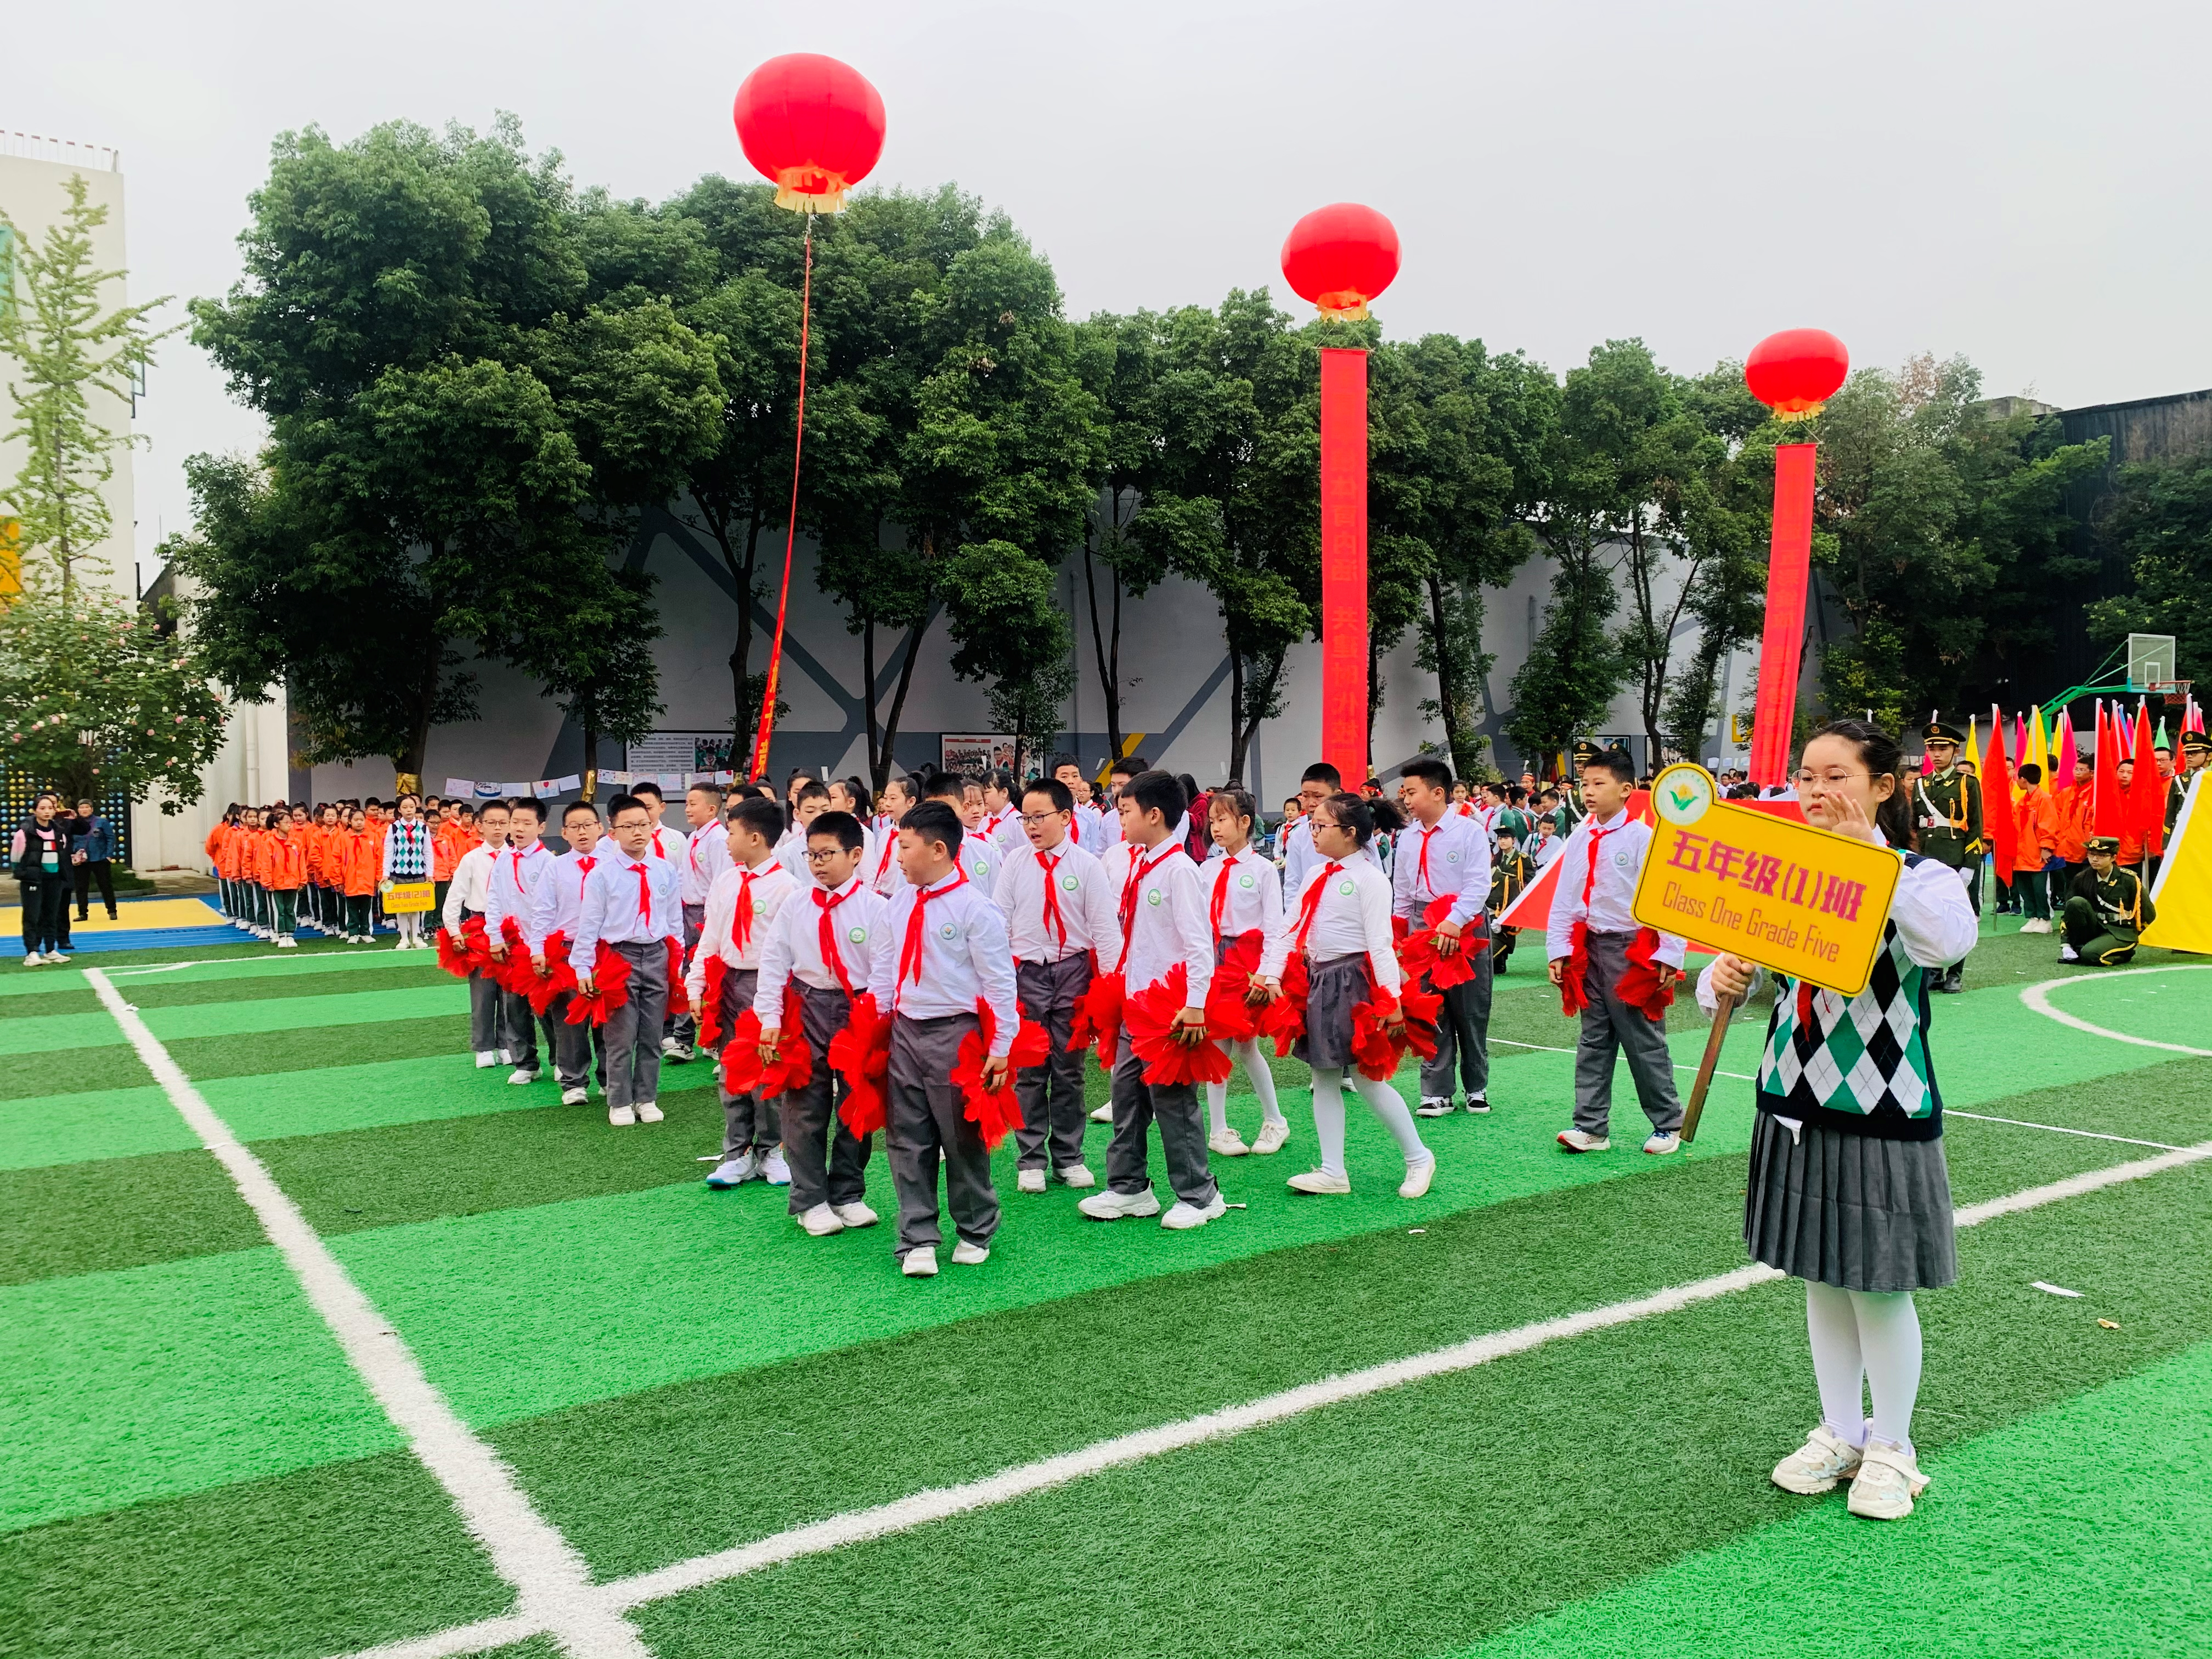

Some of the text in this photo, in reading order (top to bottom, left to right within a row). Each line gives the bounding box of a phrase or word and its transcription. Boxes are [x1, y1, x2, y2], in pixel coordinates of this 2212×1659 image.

[1667, 830, 1866, 922] 五年级(1)班
[1662, 881, 1840, 963] Class One Grade Five
